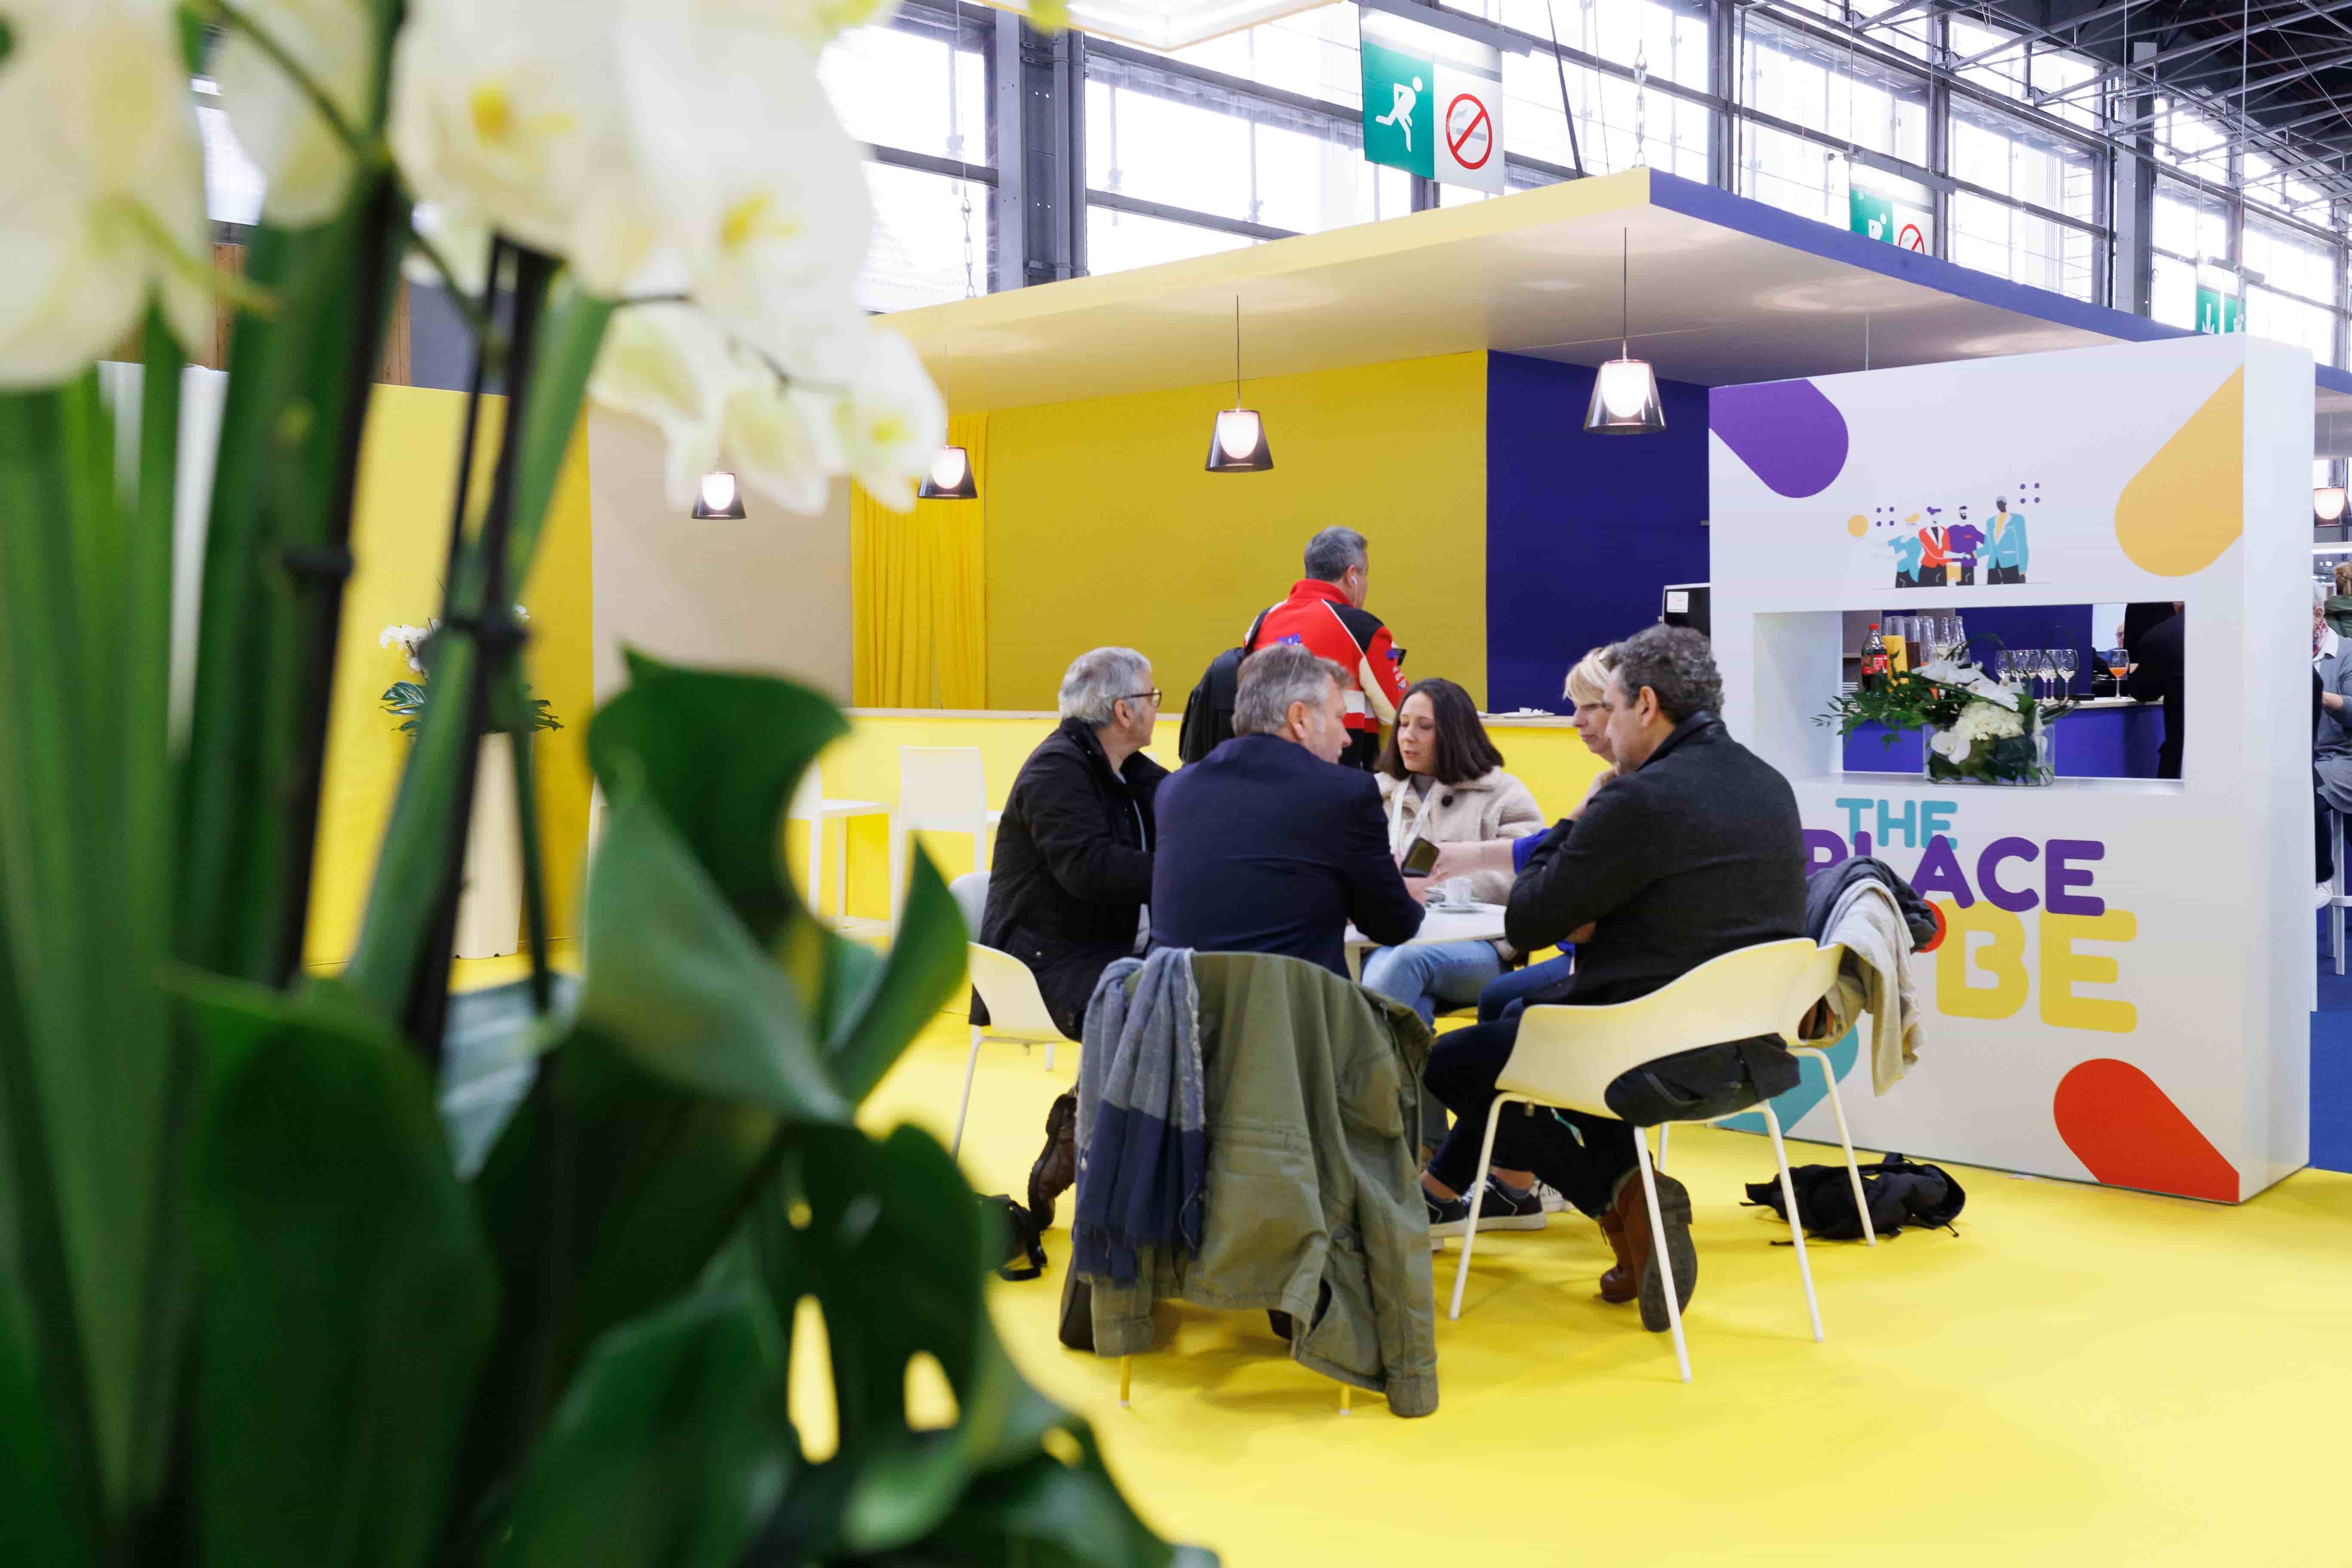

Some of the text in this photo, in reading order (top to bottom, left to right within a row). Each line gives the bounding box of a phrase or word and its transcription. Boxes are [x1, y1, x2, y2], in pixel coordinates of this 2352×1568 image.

[1835, 797, 1958, 851] THE
[1801, 829, 2104, 916] PACE
[1936, 898, 2138, 1034] BE
